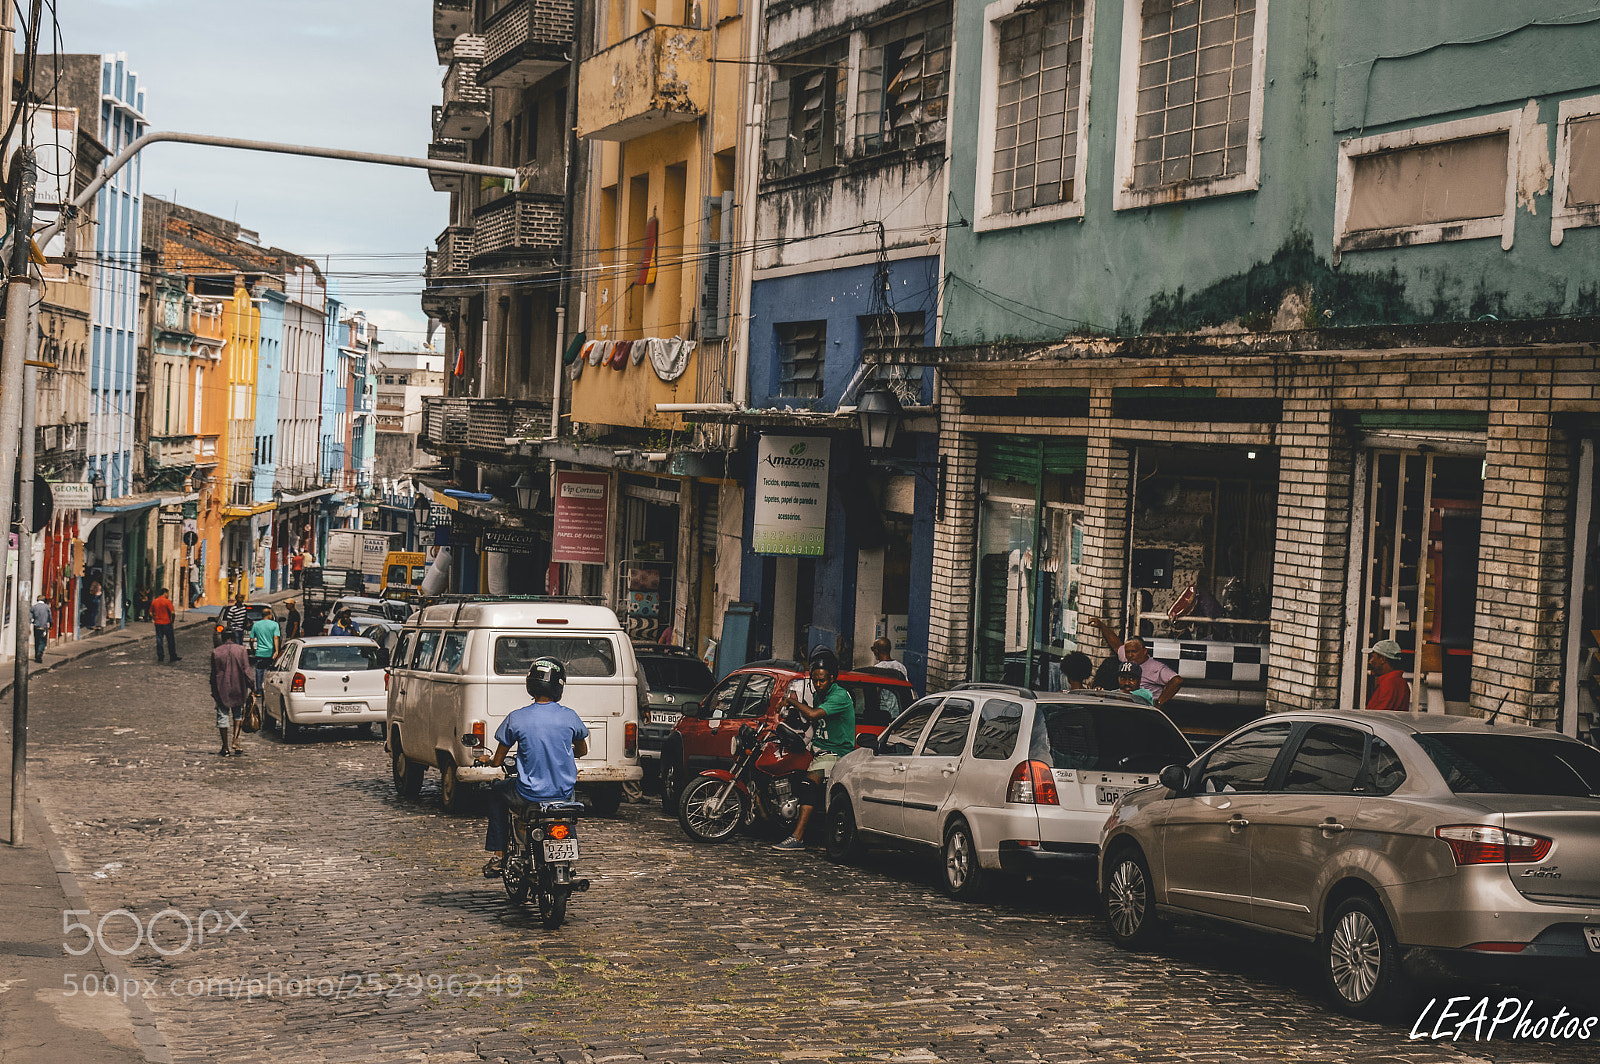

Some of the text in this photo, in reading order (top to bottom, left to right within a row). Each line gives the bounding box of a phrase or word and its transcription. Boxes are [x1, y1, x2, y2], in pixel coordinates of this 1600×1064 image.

[759, 454, 825, 468] Amazonas
[763, 478, 780, 486] Tecidos,
[781, 479, 800, 488] espumas,
[563, 485, 574, 495] Vip
[764, 495, 780, 504] tapetes,
[781, 496, 792, 504] papel
[799, 497, 813, 505] parede
[777, 513, 801, 521] acessórios.
